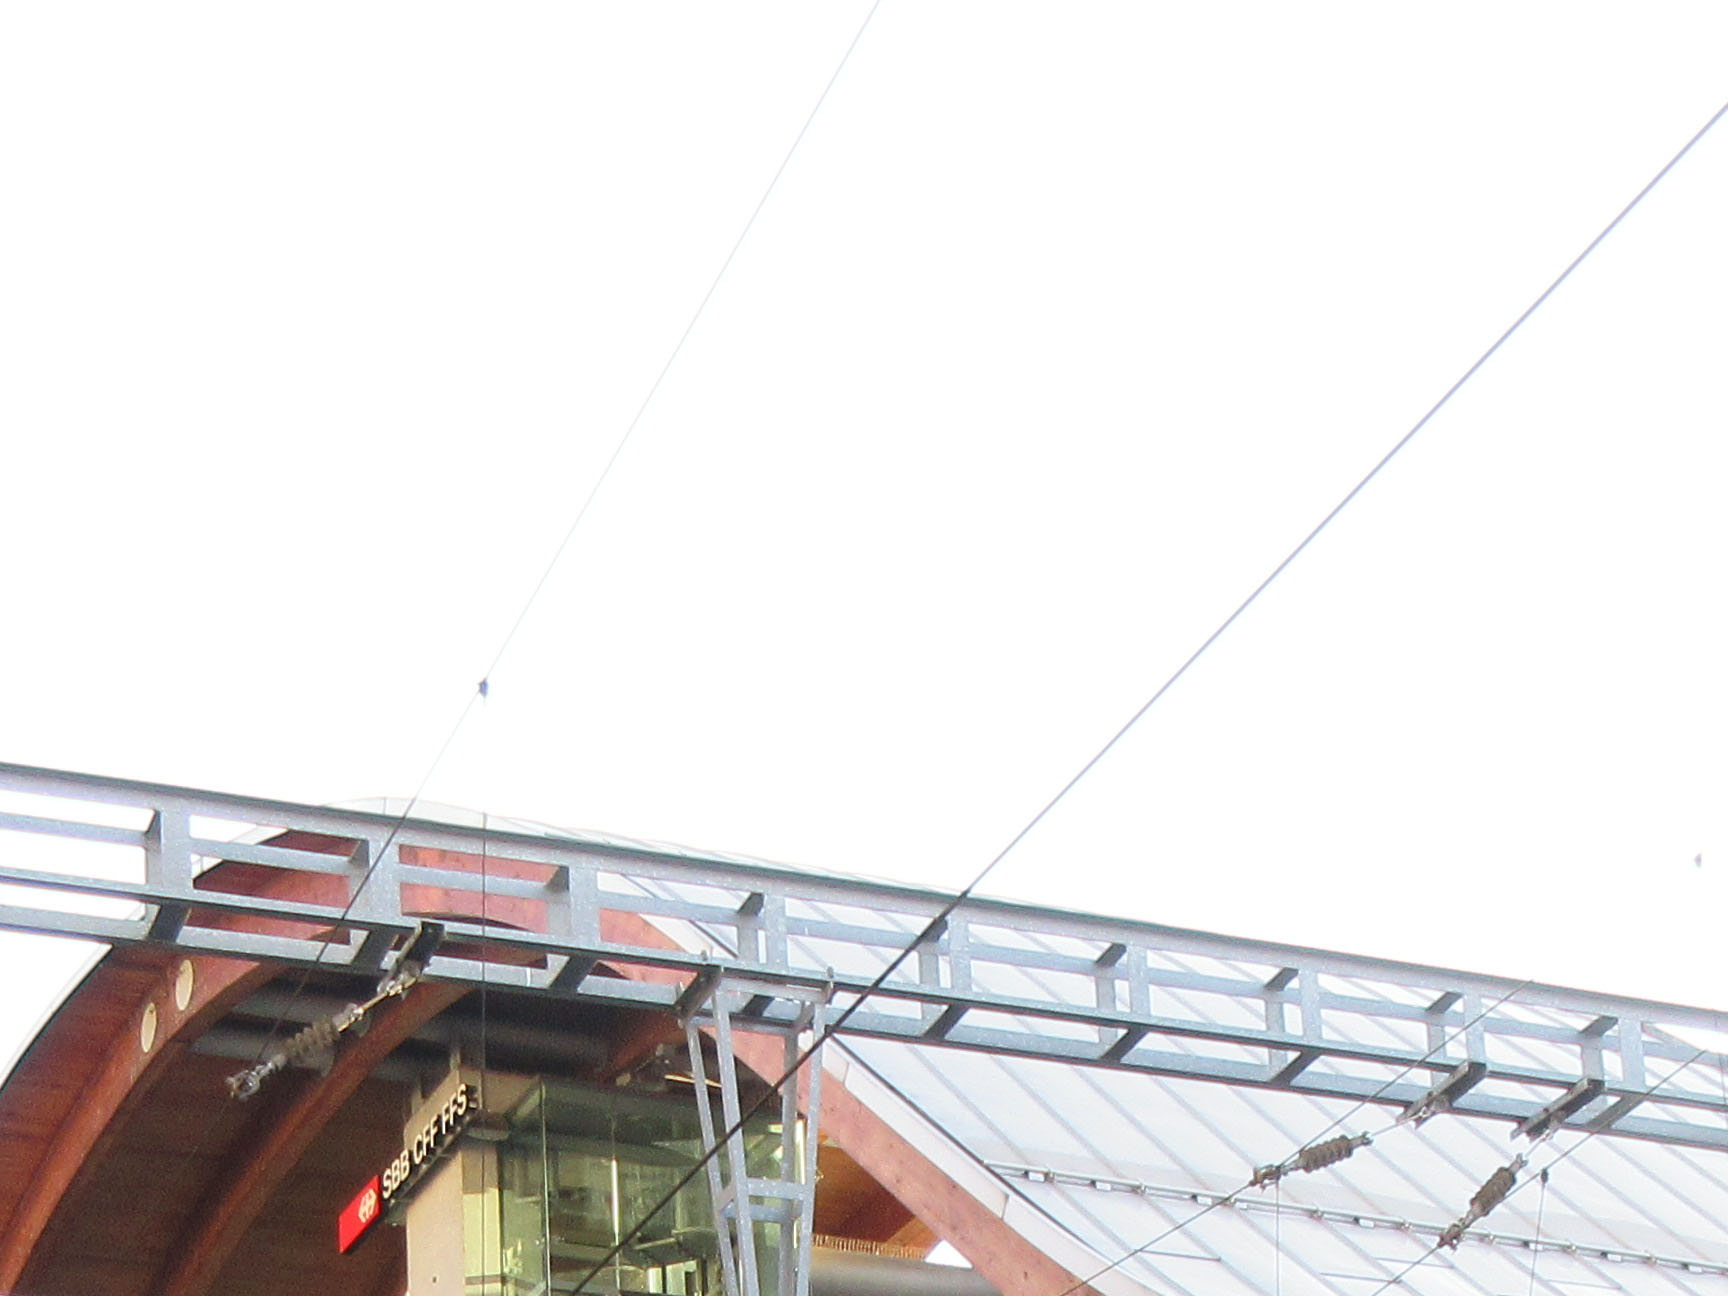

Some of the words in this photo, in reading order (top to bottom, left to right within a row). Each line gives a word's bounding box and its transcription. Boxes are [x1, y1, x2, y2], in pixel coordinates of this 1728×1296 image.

[382, 1149, 410, 1199] SBB
[413, 1114, 439, 1165] CFF
[441, 1083, 468, 1135] FFS
